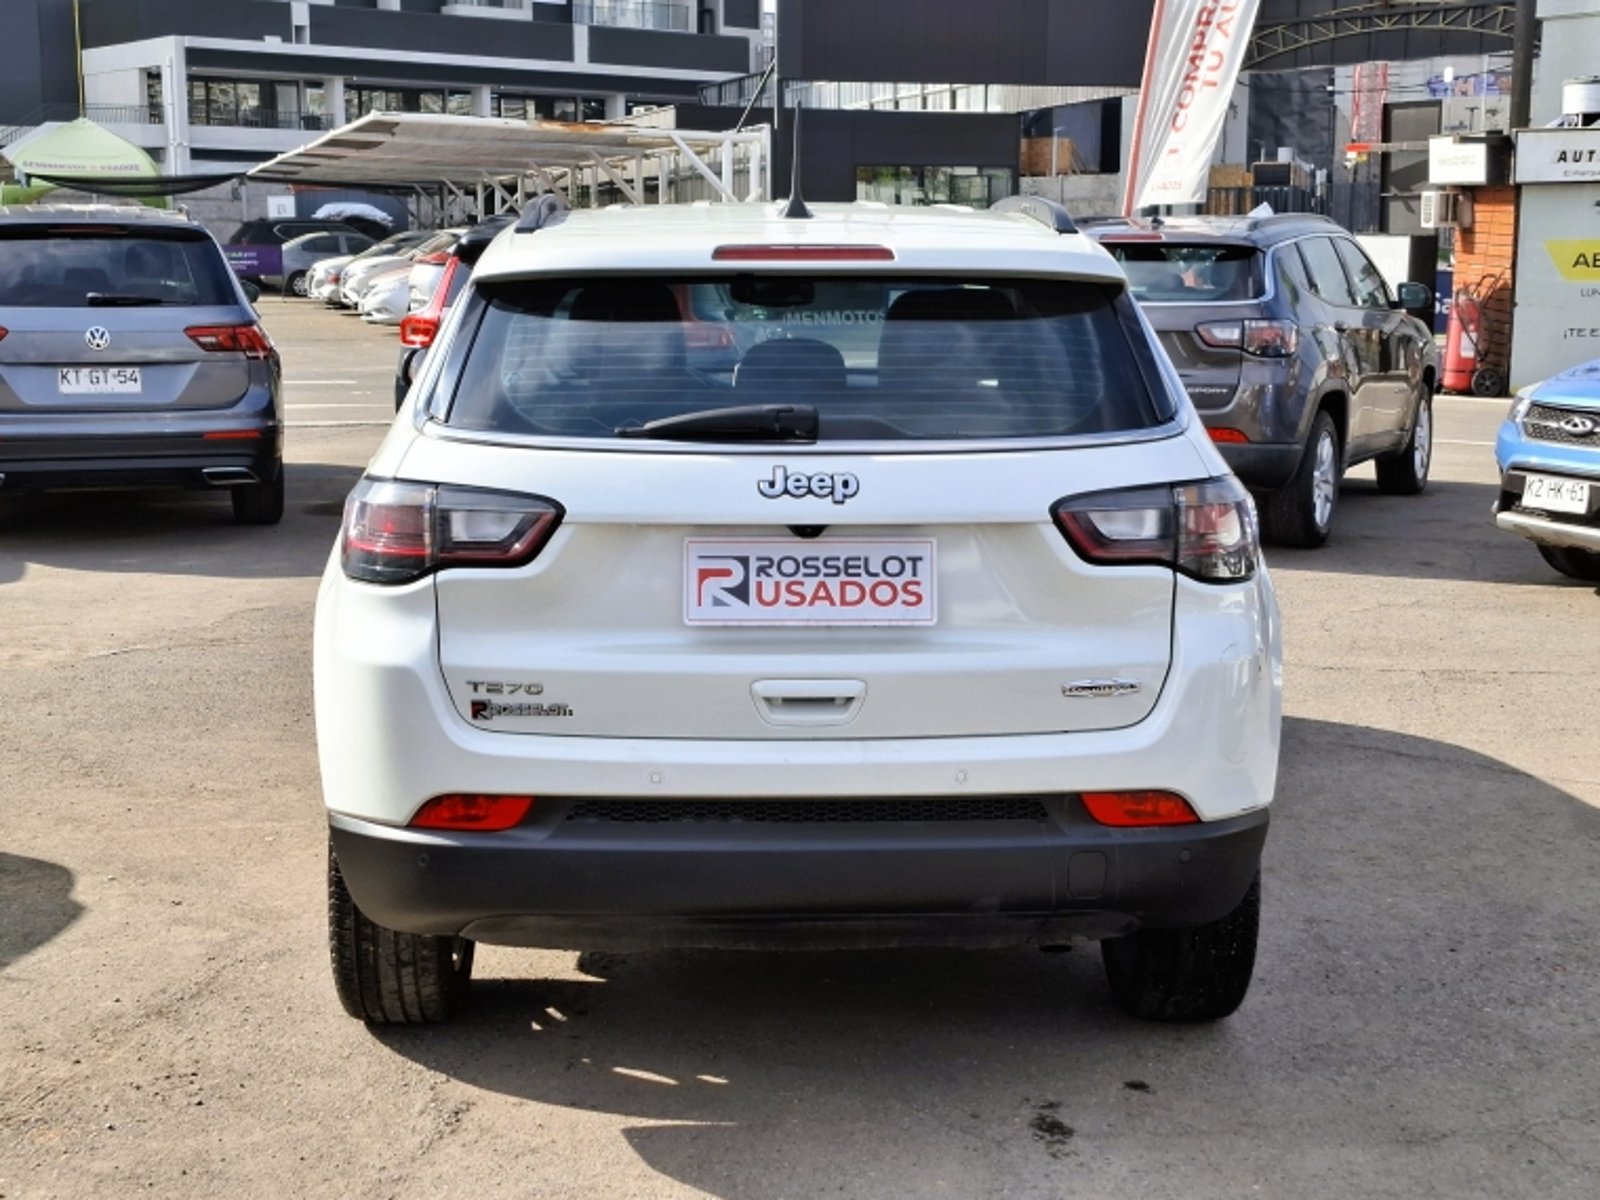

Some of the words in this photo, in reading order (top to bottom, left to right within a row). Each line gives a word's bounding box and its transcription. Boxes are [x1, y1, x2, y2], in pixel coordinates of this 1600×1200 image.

[1171, 0, 1218, 133] COMPR
[758, 465, 860, 505] Jeep
[756, 555, 923, 578] ROSSELOT
[755, 580, 924, 607] USADOS
[466, 681, 544, 695] T270
